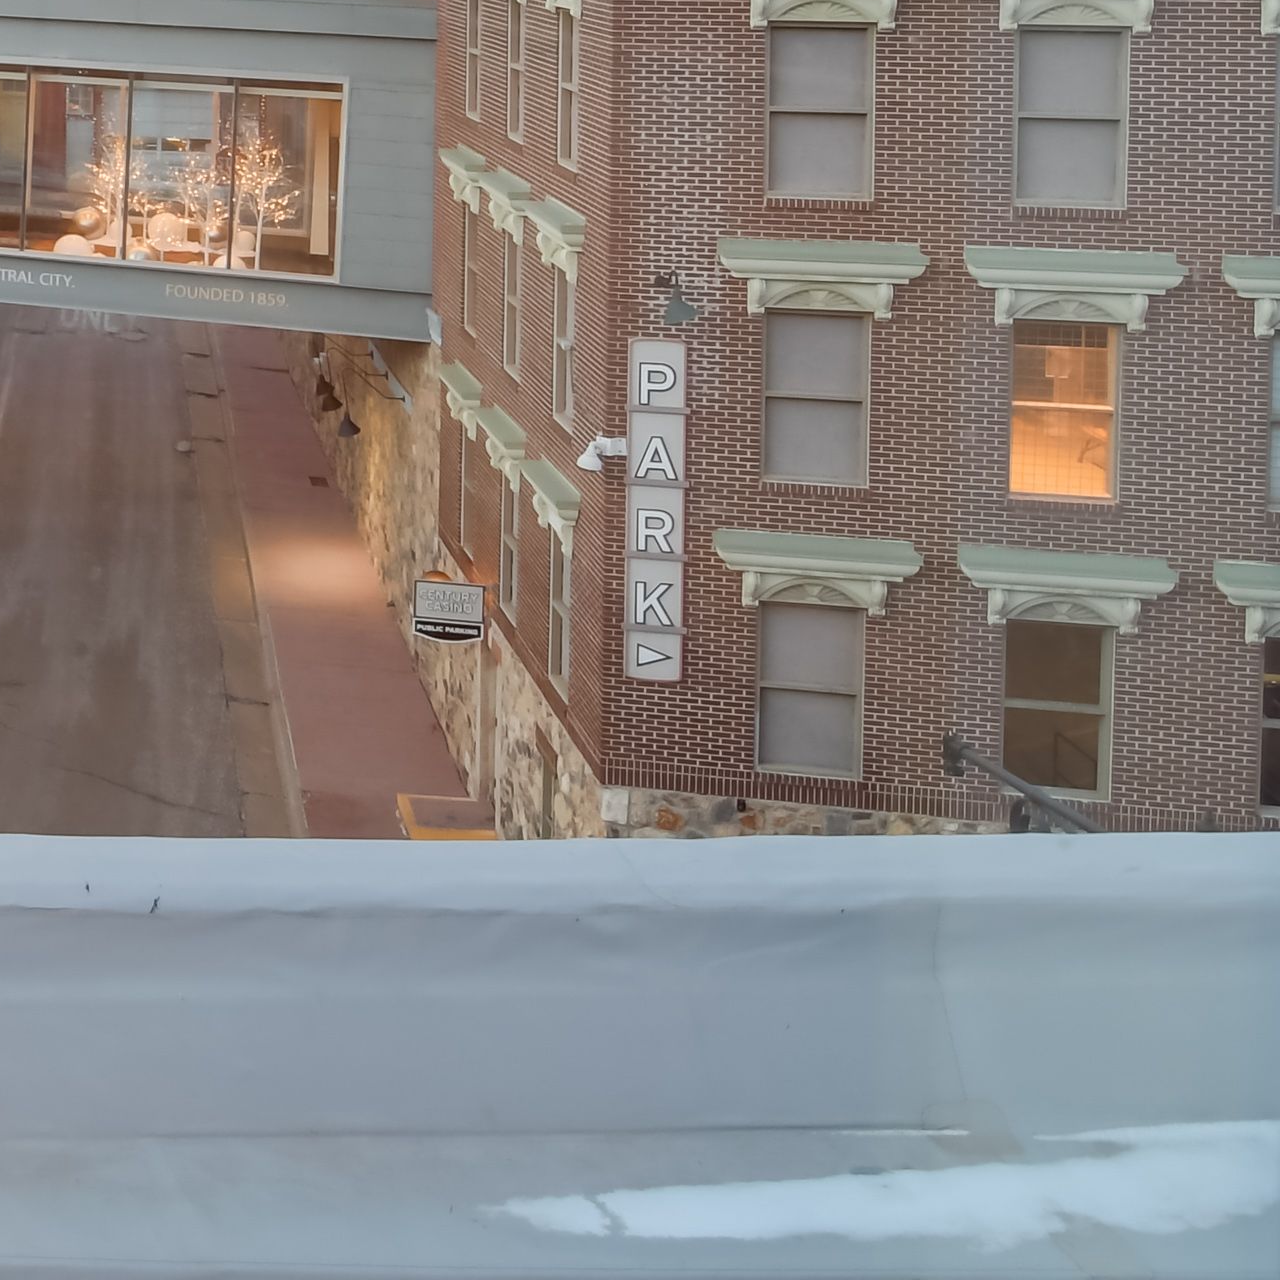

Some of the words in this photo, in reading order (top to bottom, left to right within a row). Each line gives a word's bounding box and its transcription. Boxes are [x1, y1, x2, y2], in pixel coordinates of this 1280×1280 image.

[39, 272, 76, 289] CITY.
[165, 284, 244, 303] FOUNDED
[249, 292, 288, 308] 1859.
[635, 362, 678, 627] PARK
[419, 589, 478, 602] CENTURY
[426, 600, 473, 614] CASINO
[417, 623, 443, 632] PUBLIC
